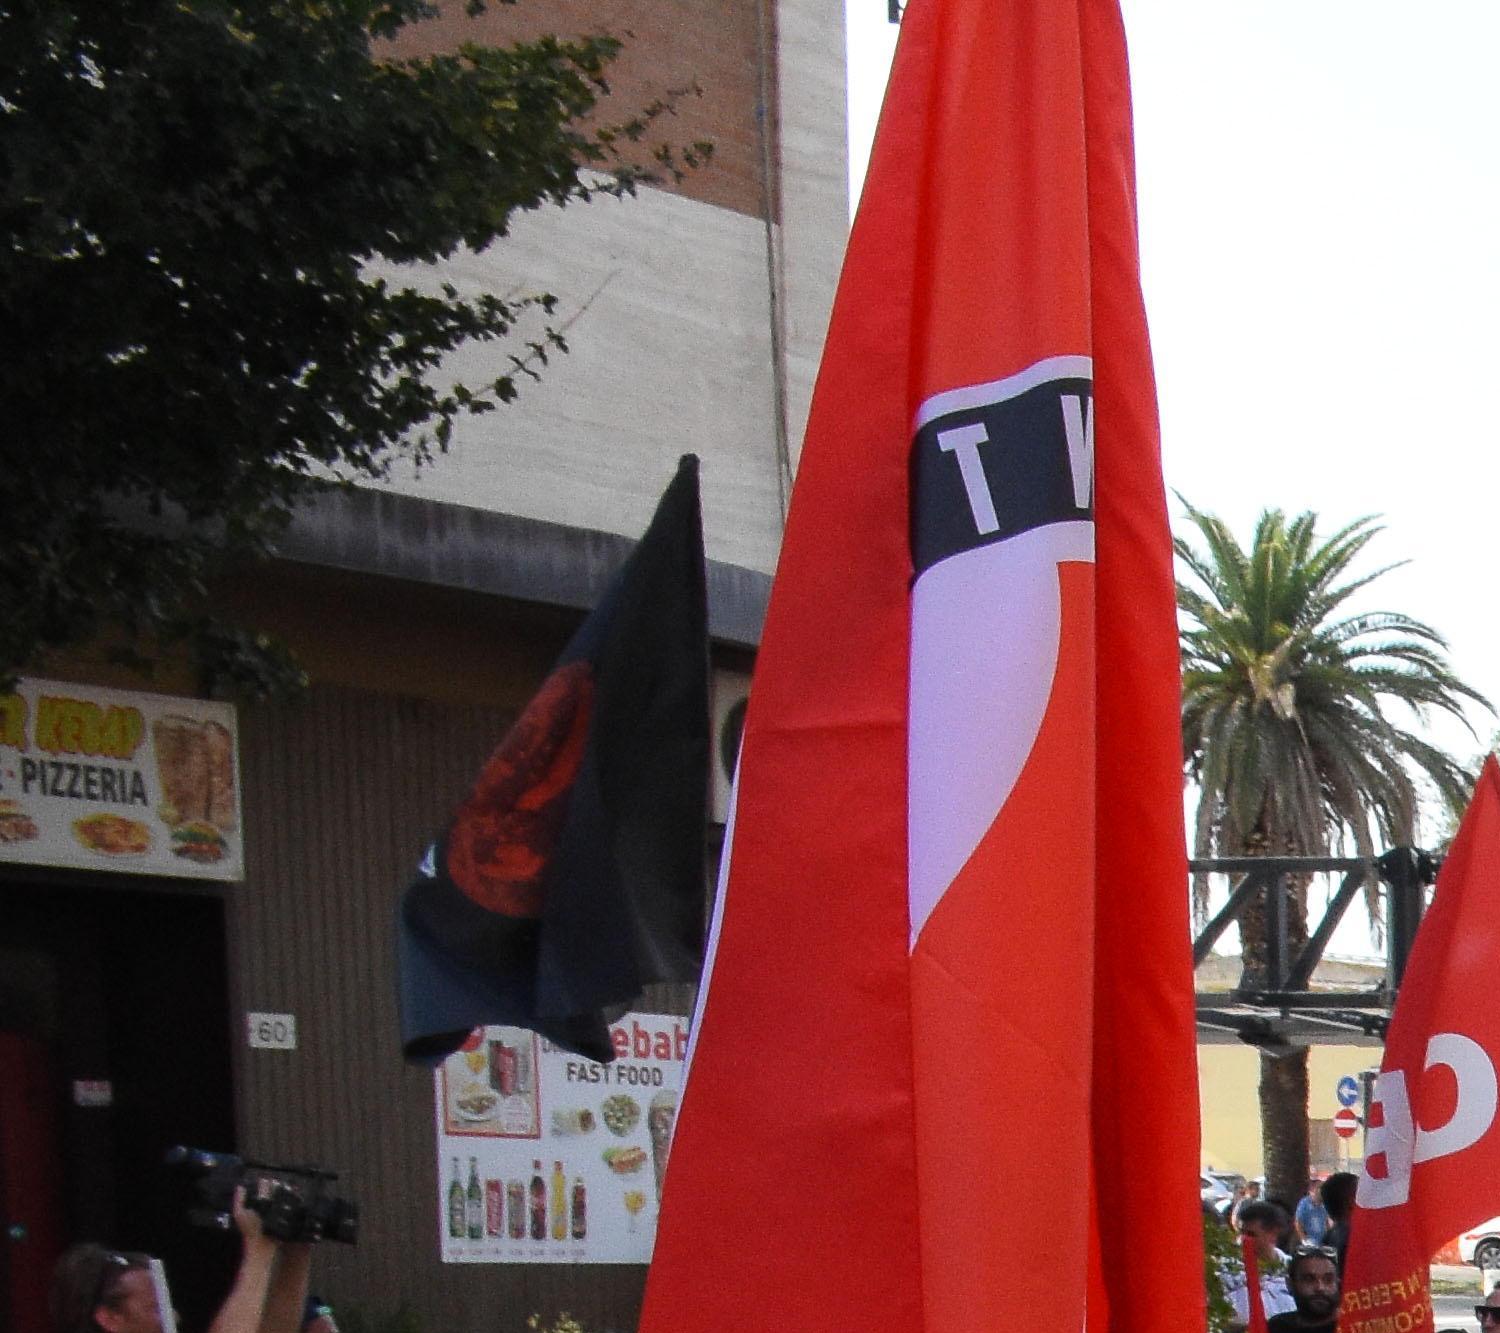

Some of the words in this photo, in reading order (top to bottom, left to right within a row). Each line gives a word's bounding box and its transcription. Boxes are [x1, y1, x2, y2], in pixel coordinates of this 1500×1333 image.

[20, 757, 148, 806] PIZZERIA
[258, 1020, 288, 1043] 60
[609, 1019, 689, 1061] eba
[567, 1062, 610, 1084] FAST
[617, 1063, 663, 1086] FOOD
